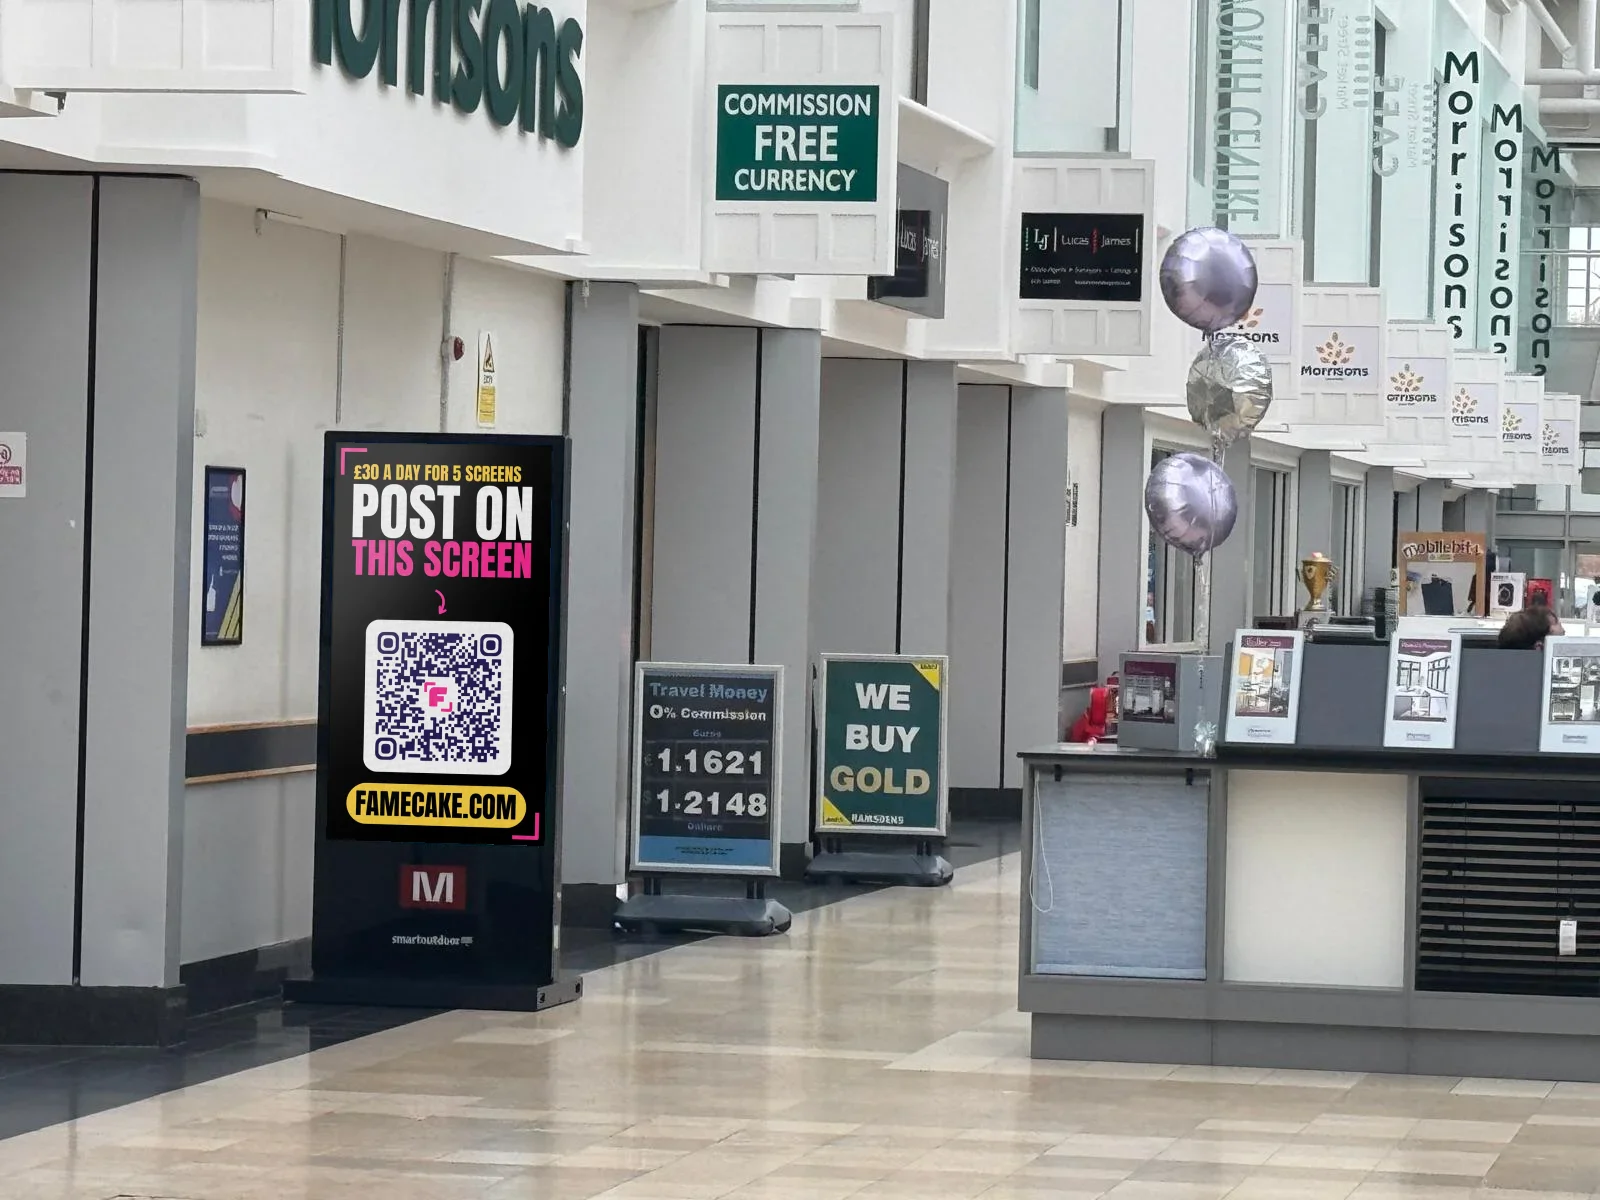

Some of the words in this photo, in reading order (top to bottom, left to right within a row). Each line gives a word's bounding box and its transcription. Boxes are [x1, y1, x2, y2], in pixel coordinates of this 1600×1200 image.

[724, 93, 871, 117] COMMISSION
[755, 124, 839, 162] FREE
[734, 168, 857, 192] CURRENCY
[1444, 51, 1480, 339] Morrisons
[1300, 365, 1369, 377] Morrisons
[353, 463, 380, 480] £30
[383, 464, 392, 480] A
[395, 464, 421, 481] DAY
[424, 465, 449, 482] FOR
[452, 465, 462, 481] 5
[465, 465, 522, 483] SCREENS
[352, 483, 461, 540] POST
[475, 485, 533, 541] ON
[352, 539, 414, 576] THIS
[423, 540, 532, 579] SCREEN
[649, 682, 705, 698] Travel
[709, 684, 768, 703] Money
[854, 682, 911, 711] WE
[649, 704, 676, 719] 0%
[680, 707, 767, 721] Commission
[845, 723, 921, 753] BUY
[657, 747, 762, 775] 1.1621
[829, 764, 931, 795] GOLD
[355, 789, 517, 821] FAMECAKE.COM
[656, 788, 767, 817] 1.2148
[391, 934, 461, 946] smartoutdoor
